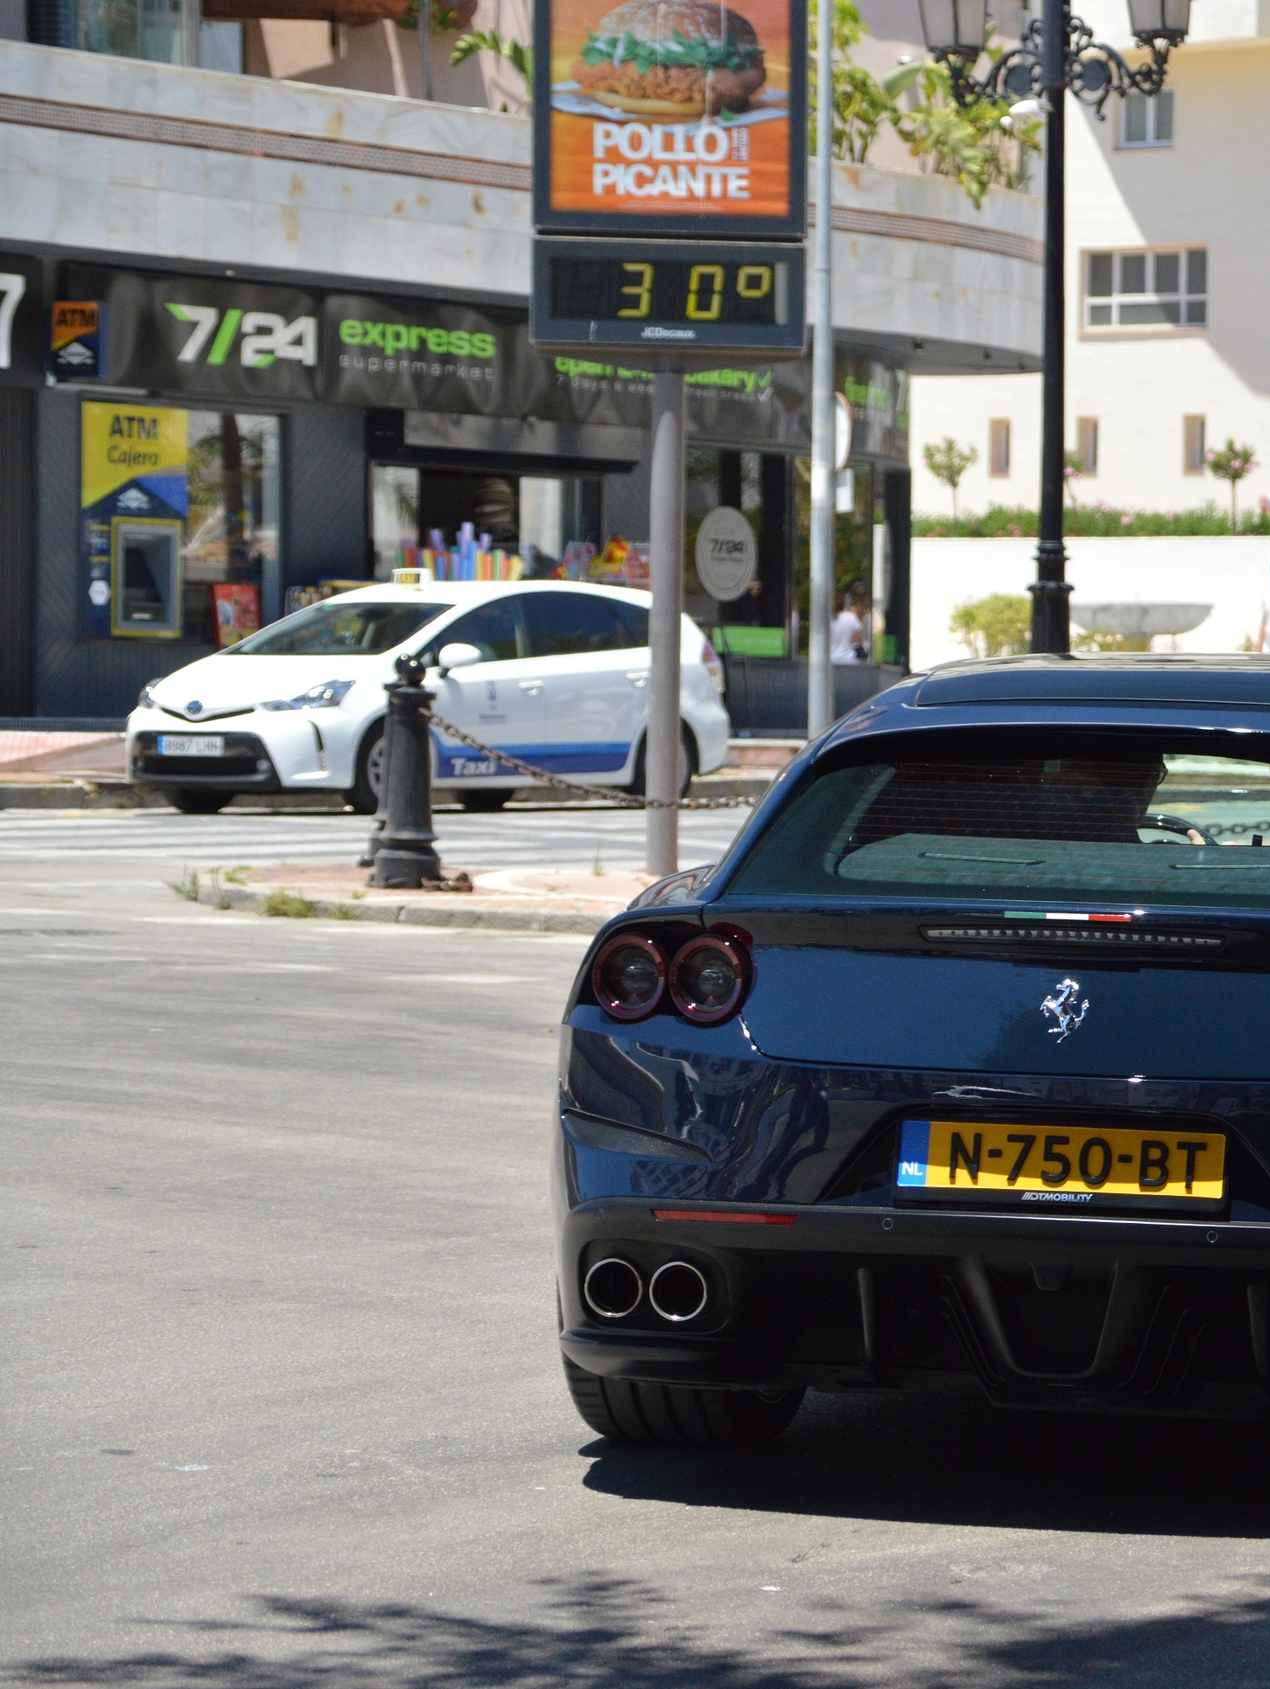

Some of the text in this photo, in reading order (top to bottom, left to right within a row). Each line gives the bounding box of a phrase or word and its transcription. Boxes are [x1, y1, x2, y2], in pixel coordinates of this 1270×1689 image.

[593, 122, 728, 162] POLLO
[592, 163, 750, 199] PICANTE
[57, 309, 96, 326] ATM
[165, 302, 318, 368] 7/24
[339, 319, 497, 359] express
[641, 327, 696, 339] JCDecaux
[339, 354, 496, 382] supermarket
[110, 415, 158, 439] ATM
[107, 446, 158, 466] Cajero
[451, 757, 496, 775] Taxi
[901, 1161, 923, 1176] NL
[949, 1131, 1207, 1191] N-750-BT
